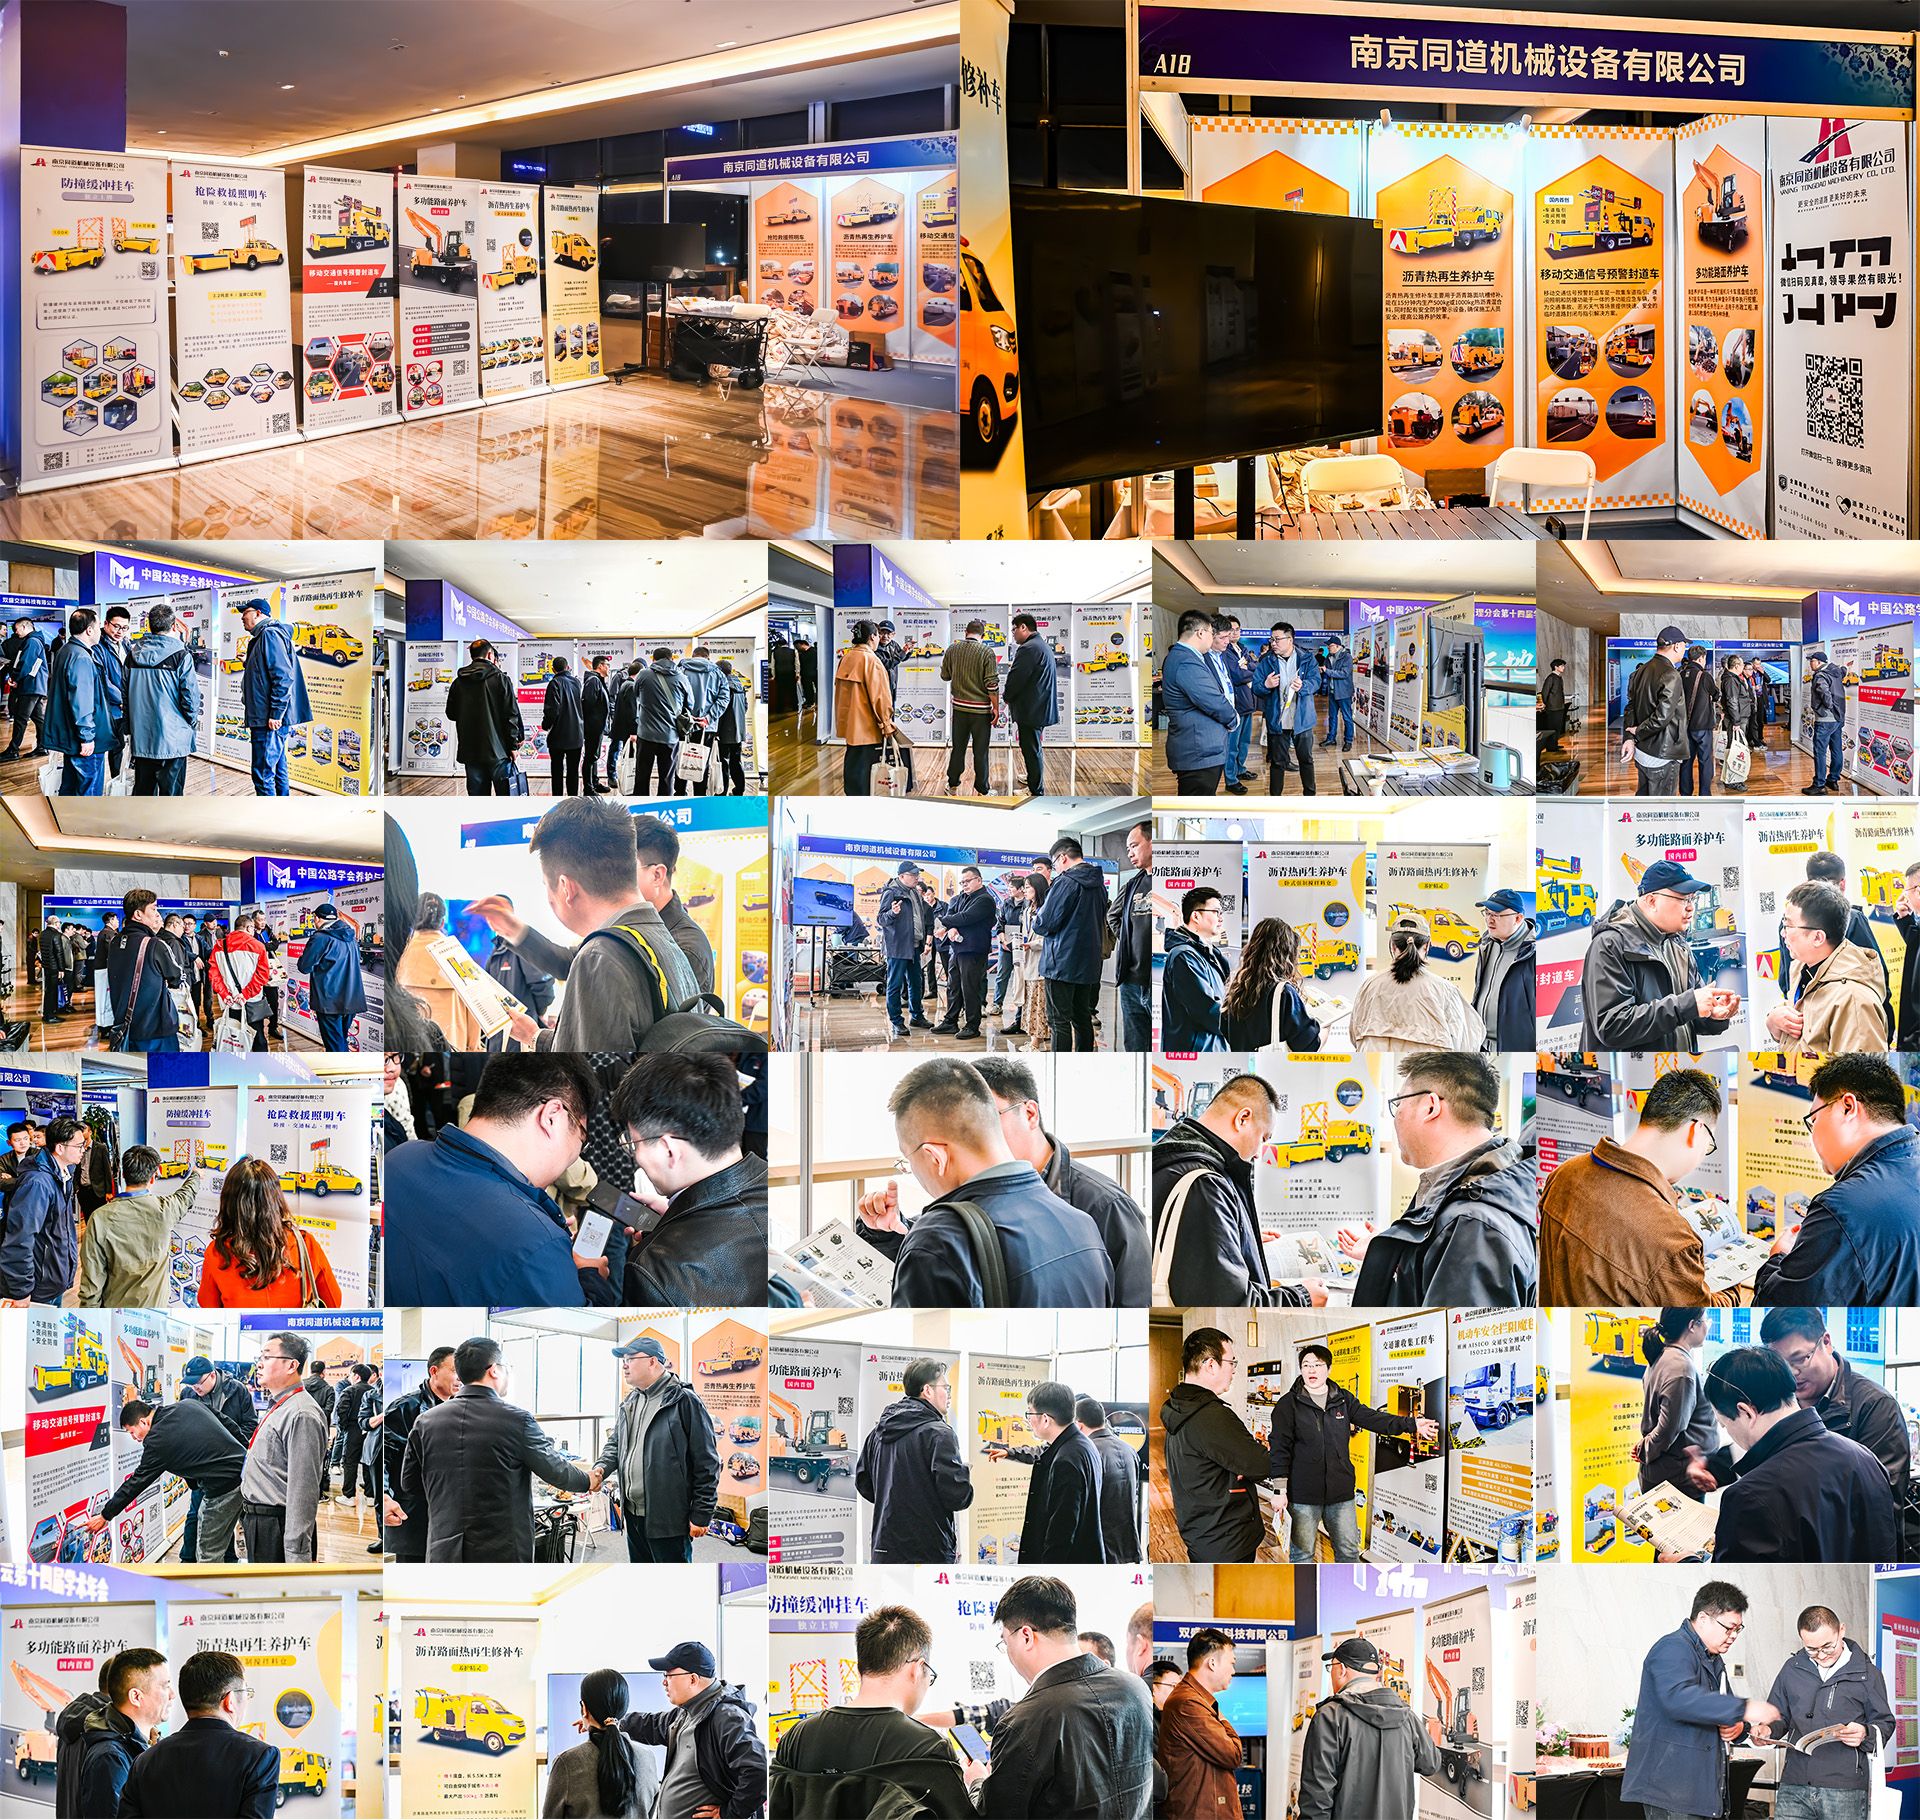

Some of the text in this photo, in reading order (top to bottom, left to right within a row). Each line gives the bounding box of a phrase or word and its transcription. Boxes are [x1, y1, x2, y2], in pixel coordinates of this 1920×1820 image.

[1153, 53, 1191, 75] A18
[1349, 33, 1746, 87] 南京同道机械设备有限公司
[961, 56, 1002, 115] 修补车
[723, 150, 870, 174] 南京同道机械设备有限公司
[1779, 147, 1896, 188] 南京同道机械设备有限公司
[61, 177, 135, 192] 防撞缓冲挂车
[195, 185, 268, 200] 抢险救援照明车
[413, 196, 468, 207] 多功能路面养护车
[309, 268, 380, 278] 移动交通信号预警封道车
[1402, 270, 1495, 283] 沥青热再生养护车
[1540, 268, 1660, 280] 移动交通信号预警封道车
[1695, 264, 1749, 279] 多功能路面养护车
[1779, 272, 1902, 288] 微信扫码见真章，领导果然有眼光！
[292, 590, 364, 603] 沥青路面热再生修补车
[1635, 831, 1726, 847] 多功能路面养护车
[1758, 829, 1825, 843] 沥青热再生养护车
[845, 843, 937, 858] 南京同道机械设备有限公司
[1268, 866, 1348, 877] 沥青热再生养护车
[1388, 866, 1478, 878] 沥青路面热再生修补车
[166, 1109, 211, 1119] 防撞缓冲挂车
[267, 1109, 346, 1121] 抢险救援照明车
[704, 1382, 756, 1390] 沥青热再生养护车
[33, 1412, 101, 1431] 移动交通信号预警封道车
[798, 1619, 839, 1631] 独立上牌
[196, 1636, 312, 1653] 沥青热再生养护车
[1431, 1628, 1476, 1649] 多功能路面养护车
[25, 1639, 128, 1655] 多功能路面养护车
[415, 1645, 524, 1659] 沥青路面热再生修补车
[59, 1660, 92, 1669] 国内首创
